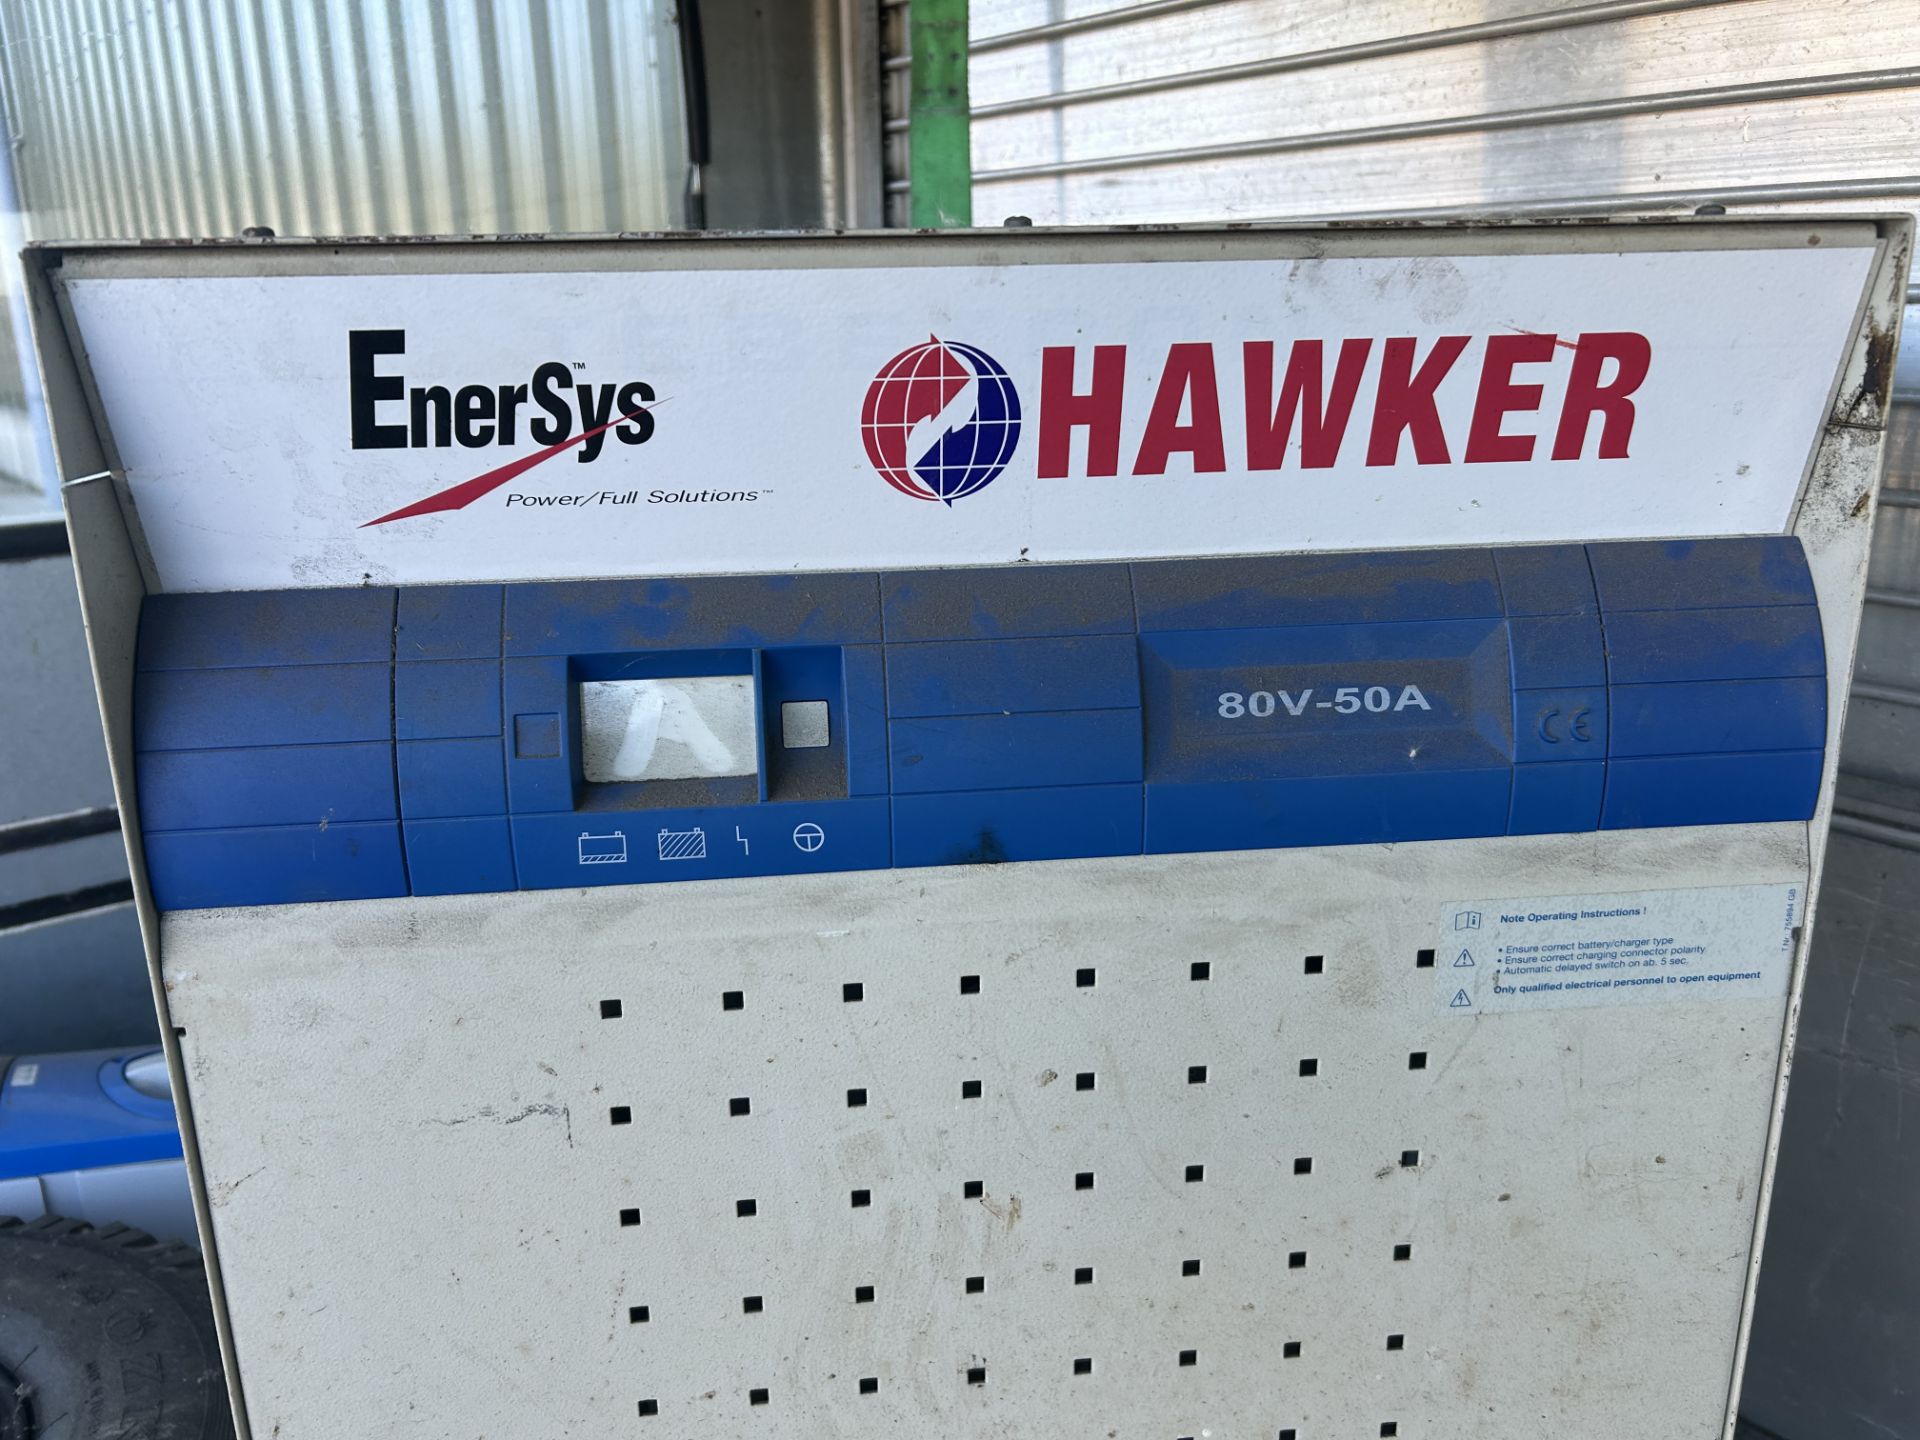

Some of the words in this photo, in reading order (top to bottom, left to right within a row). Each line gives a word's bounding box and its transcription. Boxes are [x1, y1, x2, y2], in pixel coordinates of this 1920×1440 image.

[349, 329, 656, 463] EnerSys
[1037, 332, 1652, 479] HAWKER
[505, 491, 639, 508] Power/Full
[647, 489, 759, 504] Solutions
[1217, 684, 1432, 719] 80V-50A
[1500, 914, 1526, 924] Note
[1527, 910, 1578, 923] Operating
[1580, 907, 1641, 919] Instructions
[1504, 955, 1538, 965] Ensure
[1540, 953, 1574, 963] correct
[1576, 949, 1618, 961] charging
[1619, 947, 1668, 958] connector
[1670, 945, 1706, 956] polarity
[1505, 944, 1539, 955] Ensure
[1541, 942, 1575, 952] correct
[1577, 938, 1650, 951] battery/charger
[1652, 936, 1674, 948] type
[1503, 965, 1552, 975] Automatic
[1555, 960, 1592, 972] delayed
[1594, 959, 1625, 970] switch
[1628, 960, 1640, 968] on
[1660, 957, 1667, 966] 5
[1493, 984, 1517, 995] Only
[1519, 981, 1563, 994] qualified
[1564, 978, 1611, 990] electrical
[1613, 975, 1664, 988] personnel
[1666, 975, 1677, 984] to
[1679, 974, 1705, 985] open
[1707, 971, 1761, 983] equipment
